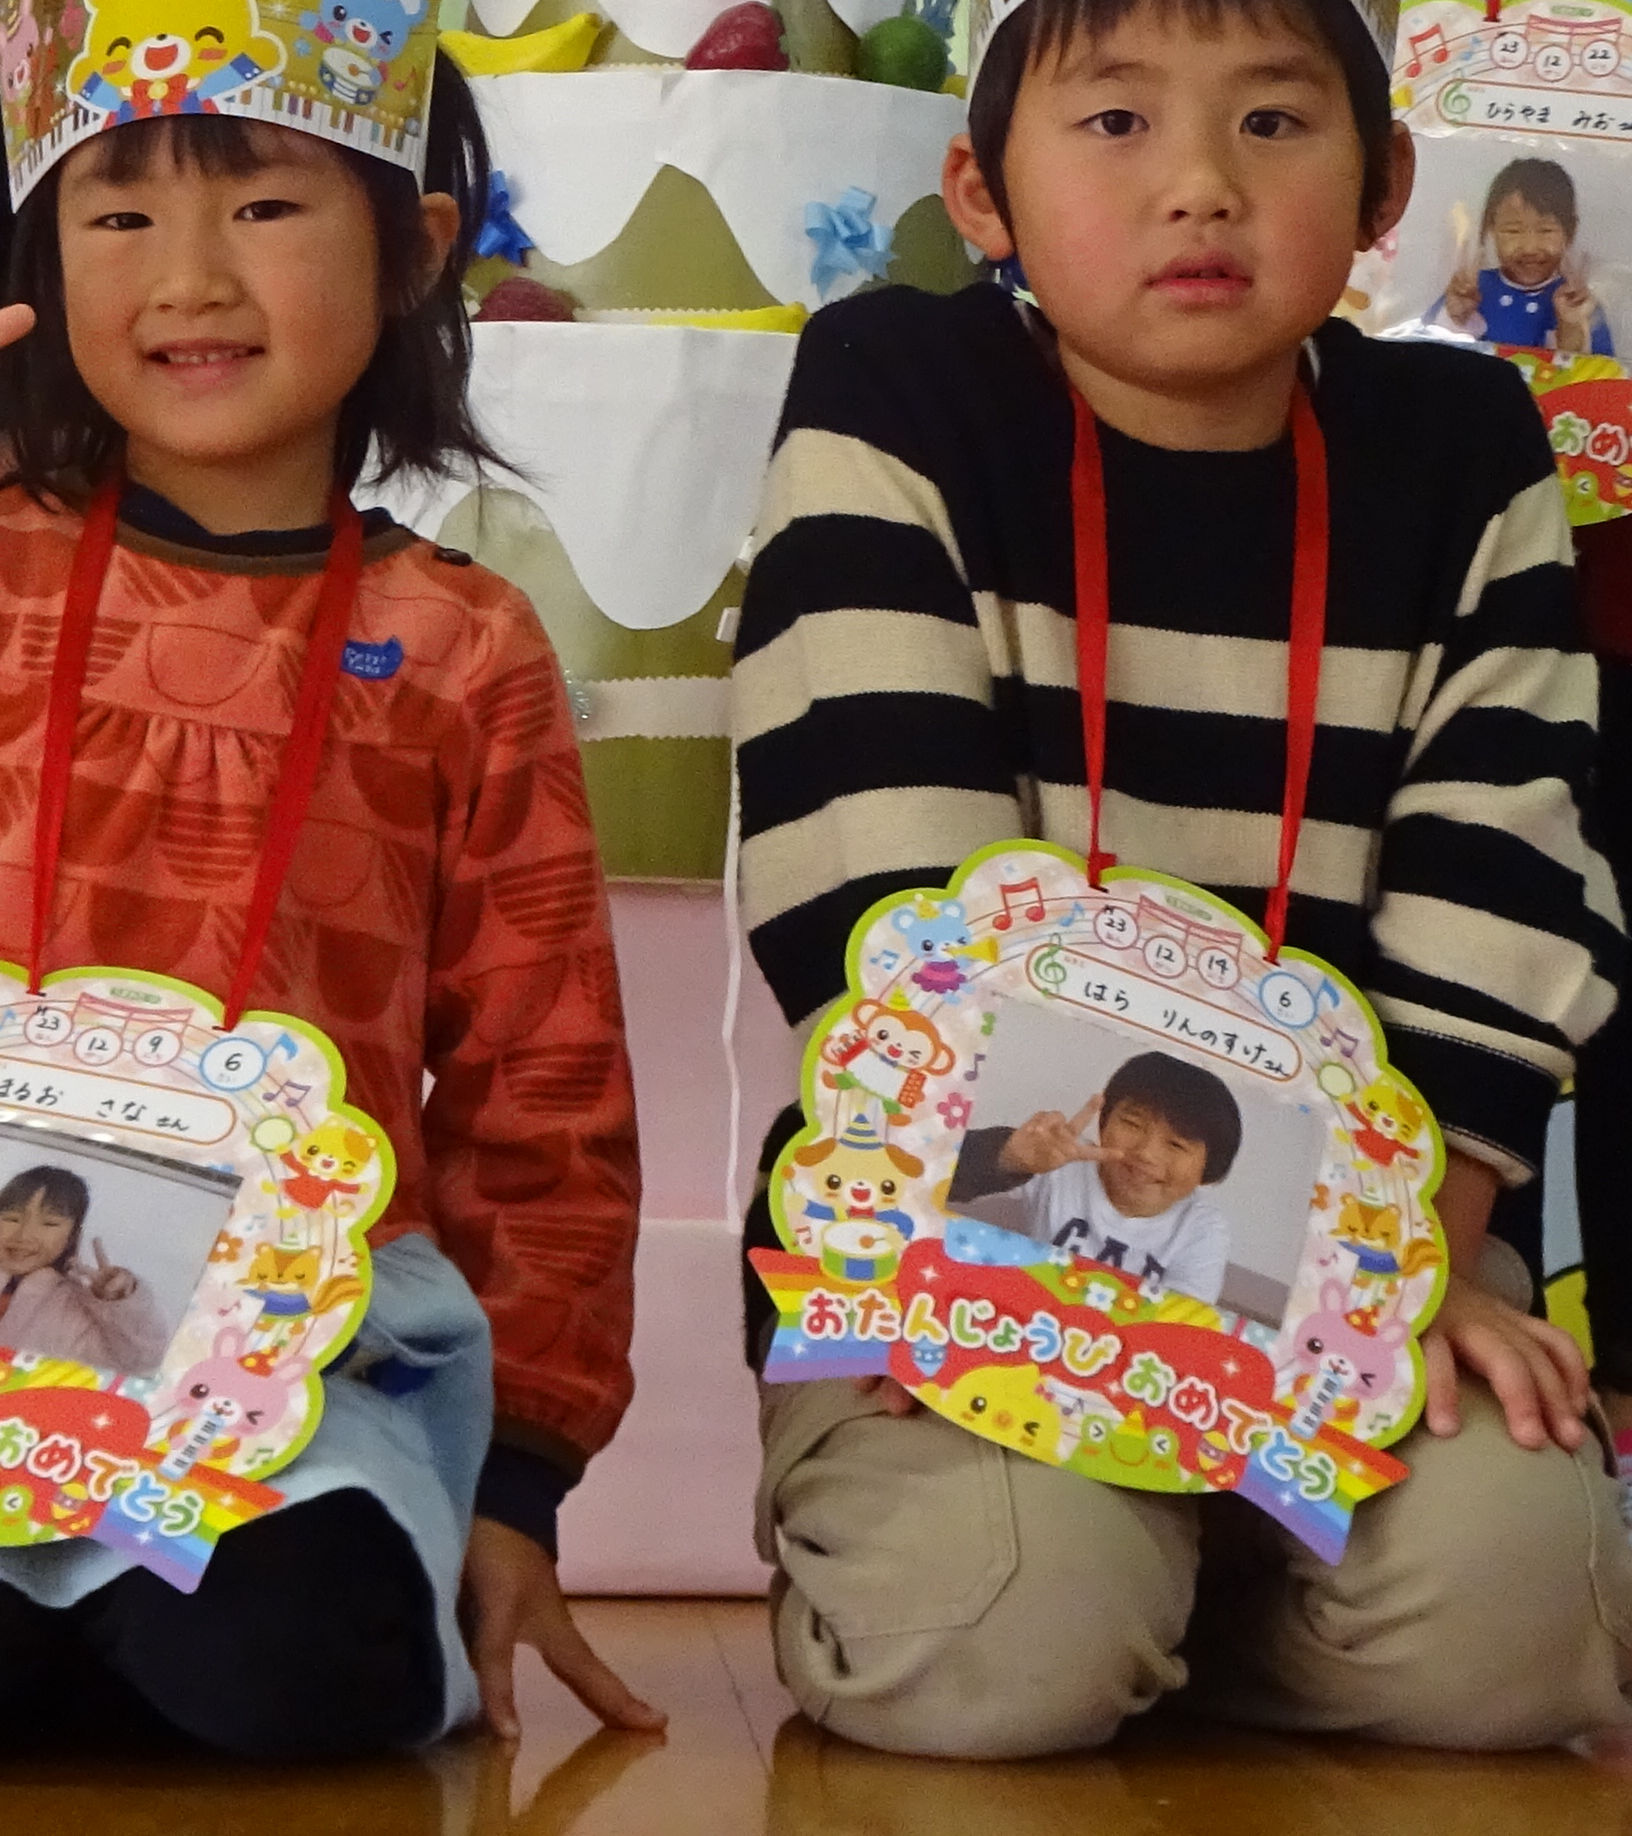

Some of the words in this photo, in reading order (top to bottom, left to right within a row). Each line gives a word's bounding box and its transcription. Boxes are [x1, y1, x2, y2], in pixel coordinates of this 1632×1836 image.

[1588, 48, 1612, 60] 22
[1083, 981, 1131, 1012] はら
[1154, 944, 1176, 962] 12
[1279, 991, 1292, 1008] 6
[36, 1017, 60, 1031] 23
[87, 1036, 110, 1052] 12
[148, 1035, 164, 1054] 9
[224, 1052, 244, 1072] 6
[798, 1288, 1119, 1376] おたんじょうび
[1122, 1353, 1339, 1503] おめでとう
